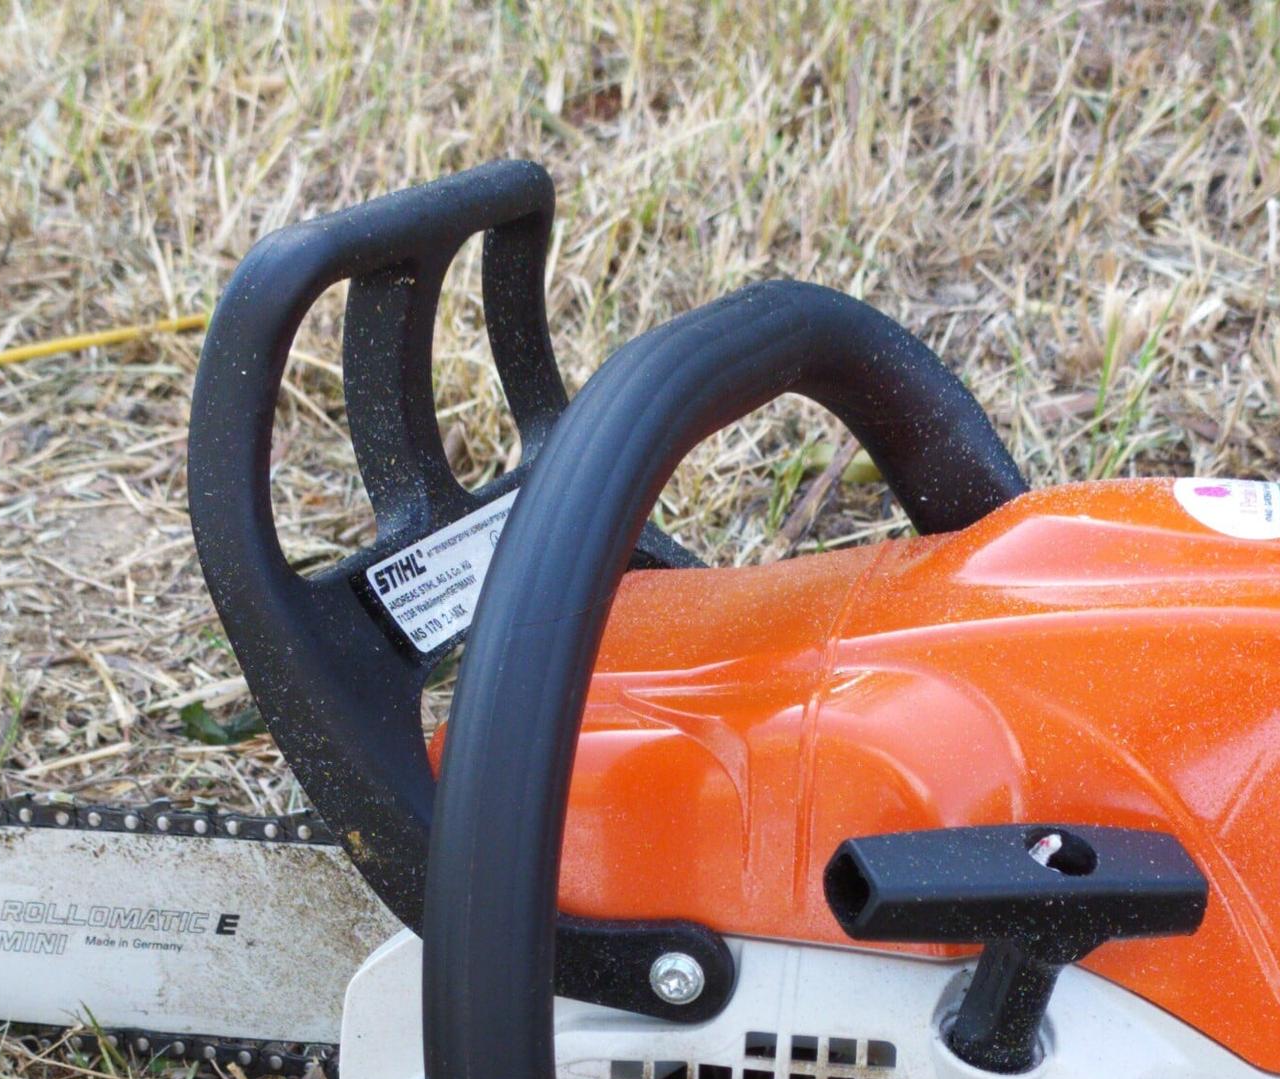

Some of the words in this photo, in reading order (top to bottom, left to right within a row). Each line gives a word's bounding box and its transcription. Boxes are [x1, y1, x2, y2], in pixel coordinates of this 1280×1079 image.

[388, 590, 421, 610] ANDREAS
[419, 580, 437, 596] STIHL
[436, 573, 448, 586] AG
[462, 560, 472, 572] KG
[410, 627, 428, 643] MS
[425, 620, 442, 635] 170
[0, 900, 208, 934] ROLLOMATIC
[216, 913, 241, 936] E
[85, 935, 116, 948] Made
[119, 938, 129, 948] in
[132, 938, 185, 953] Germany
